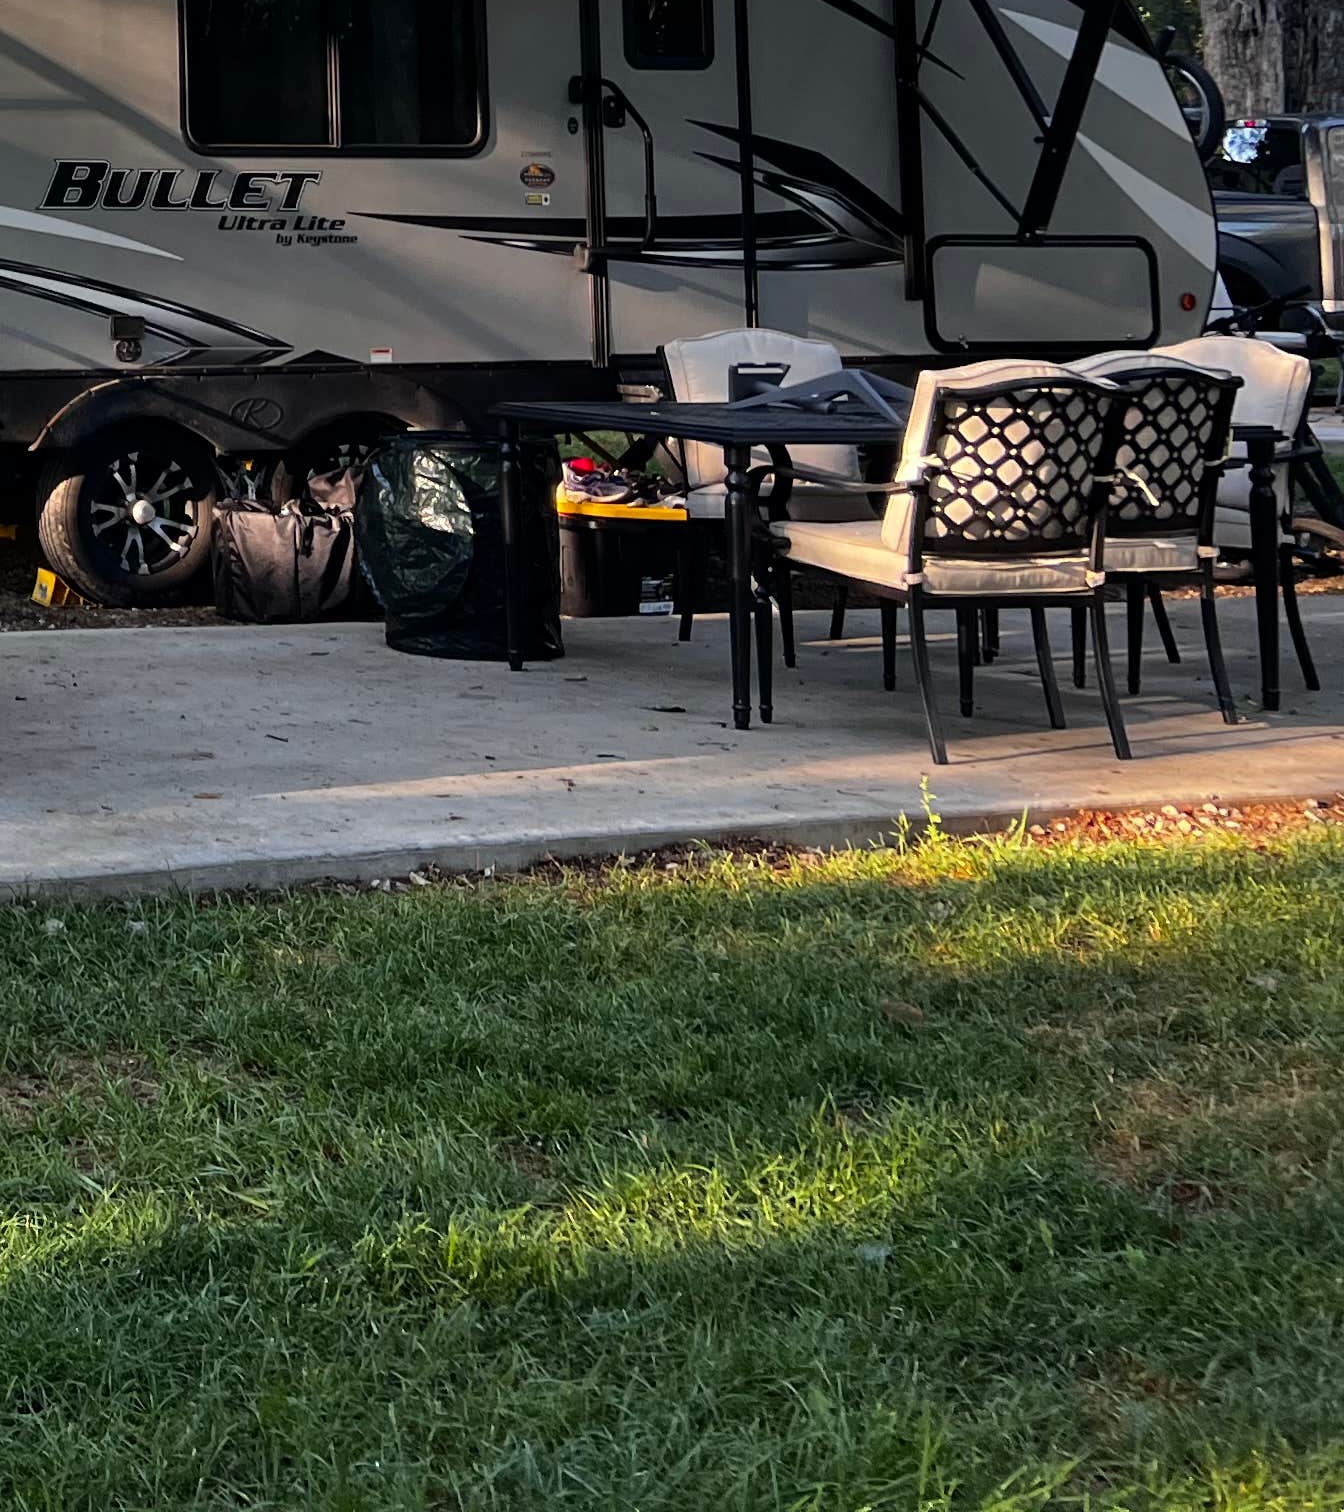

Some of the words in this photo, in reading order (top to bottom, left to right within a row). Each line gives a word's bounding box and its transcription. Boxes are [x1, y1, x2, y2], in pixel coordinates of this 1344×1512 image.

[39, 158, 323, 211] BULLET
[217, 215, 288, 231] Ultra
[292, 215, 346, 231] Lite
[275, 233, 293, 247] by
[296, 233, 359, 247] Keystone
